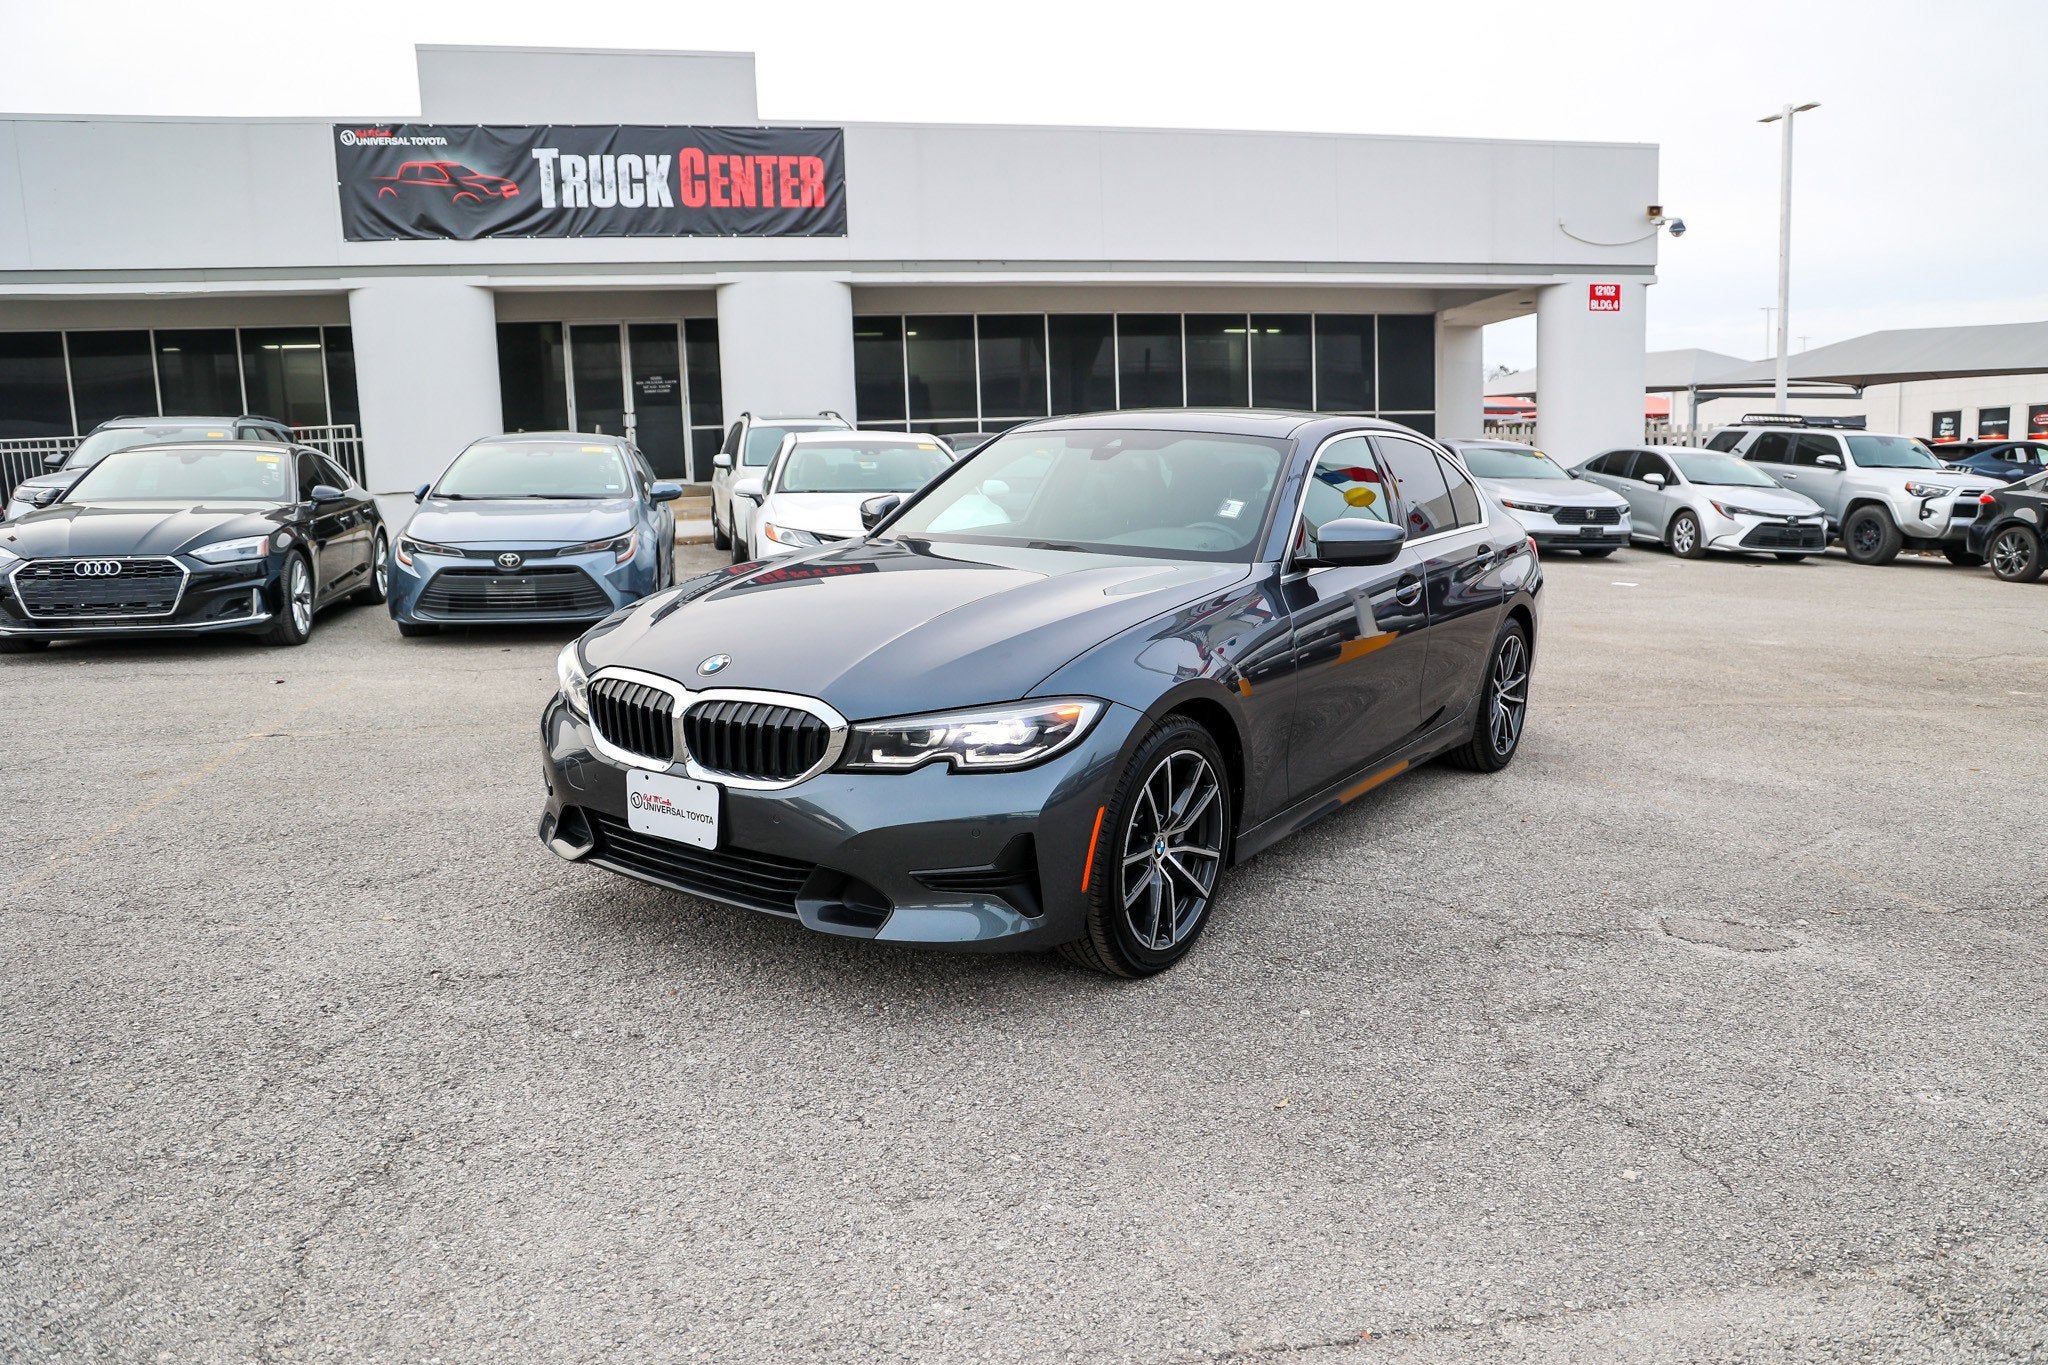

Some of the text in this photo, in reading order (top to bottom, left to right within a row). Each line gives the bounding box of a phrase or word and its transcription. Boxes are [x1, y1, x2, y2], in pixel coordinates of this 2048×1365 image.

[356, 136, 448, 146] UNIVERSAL TOYOTA
[532, 147, 827, 209] TRUCK CENTER
[1595, 285, 1616, 296] 12102
[643, 801, 714, 825] UNIVERSAL TOYOTA
